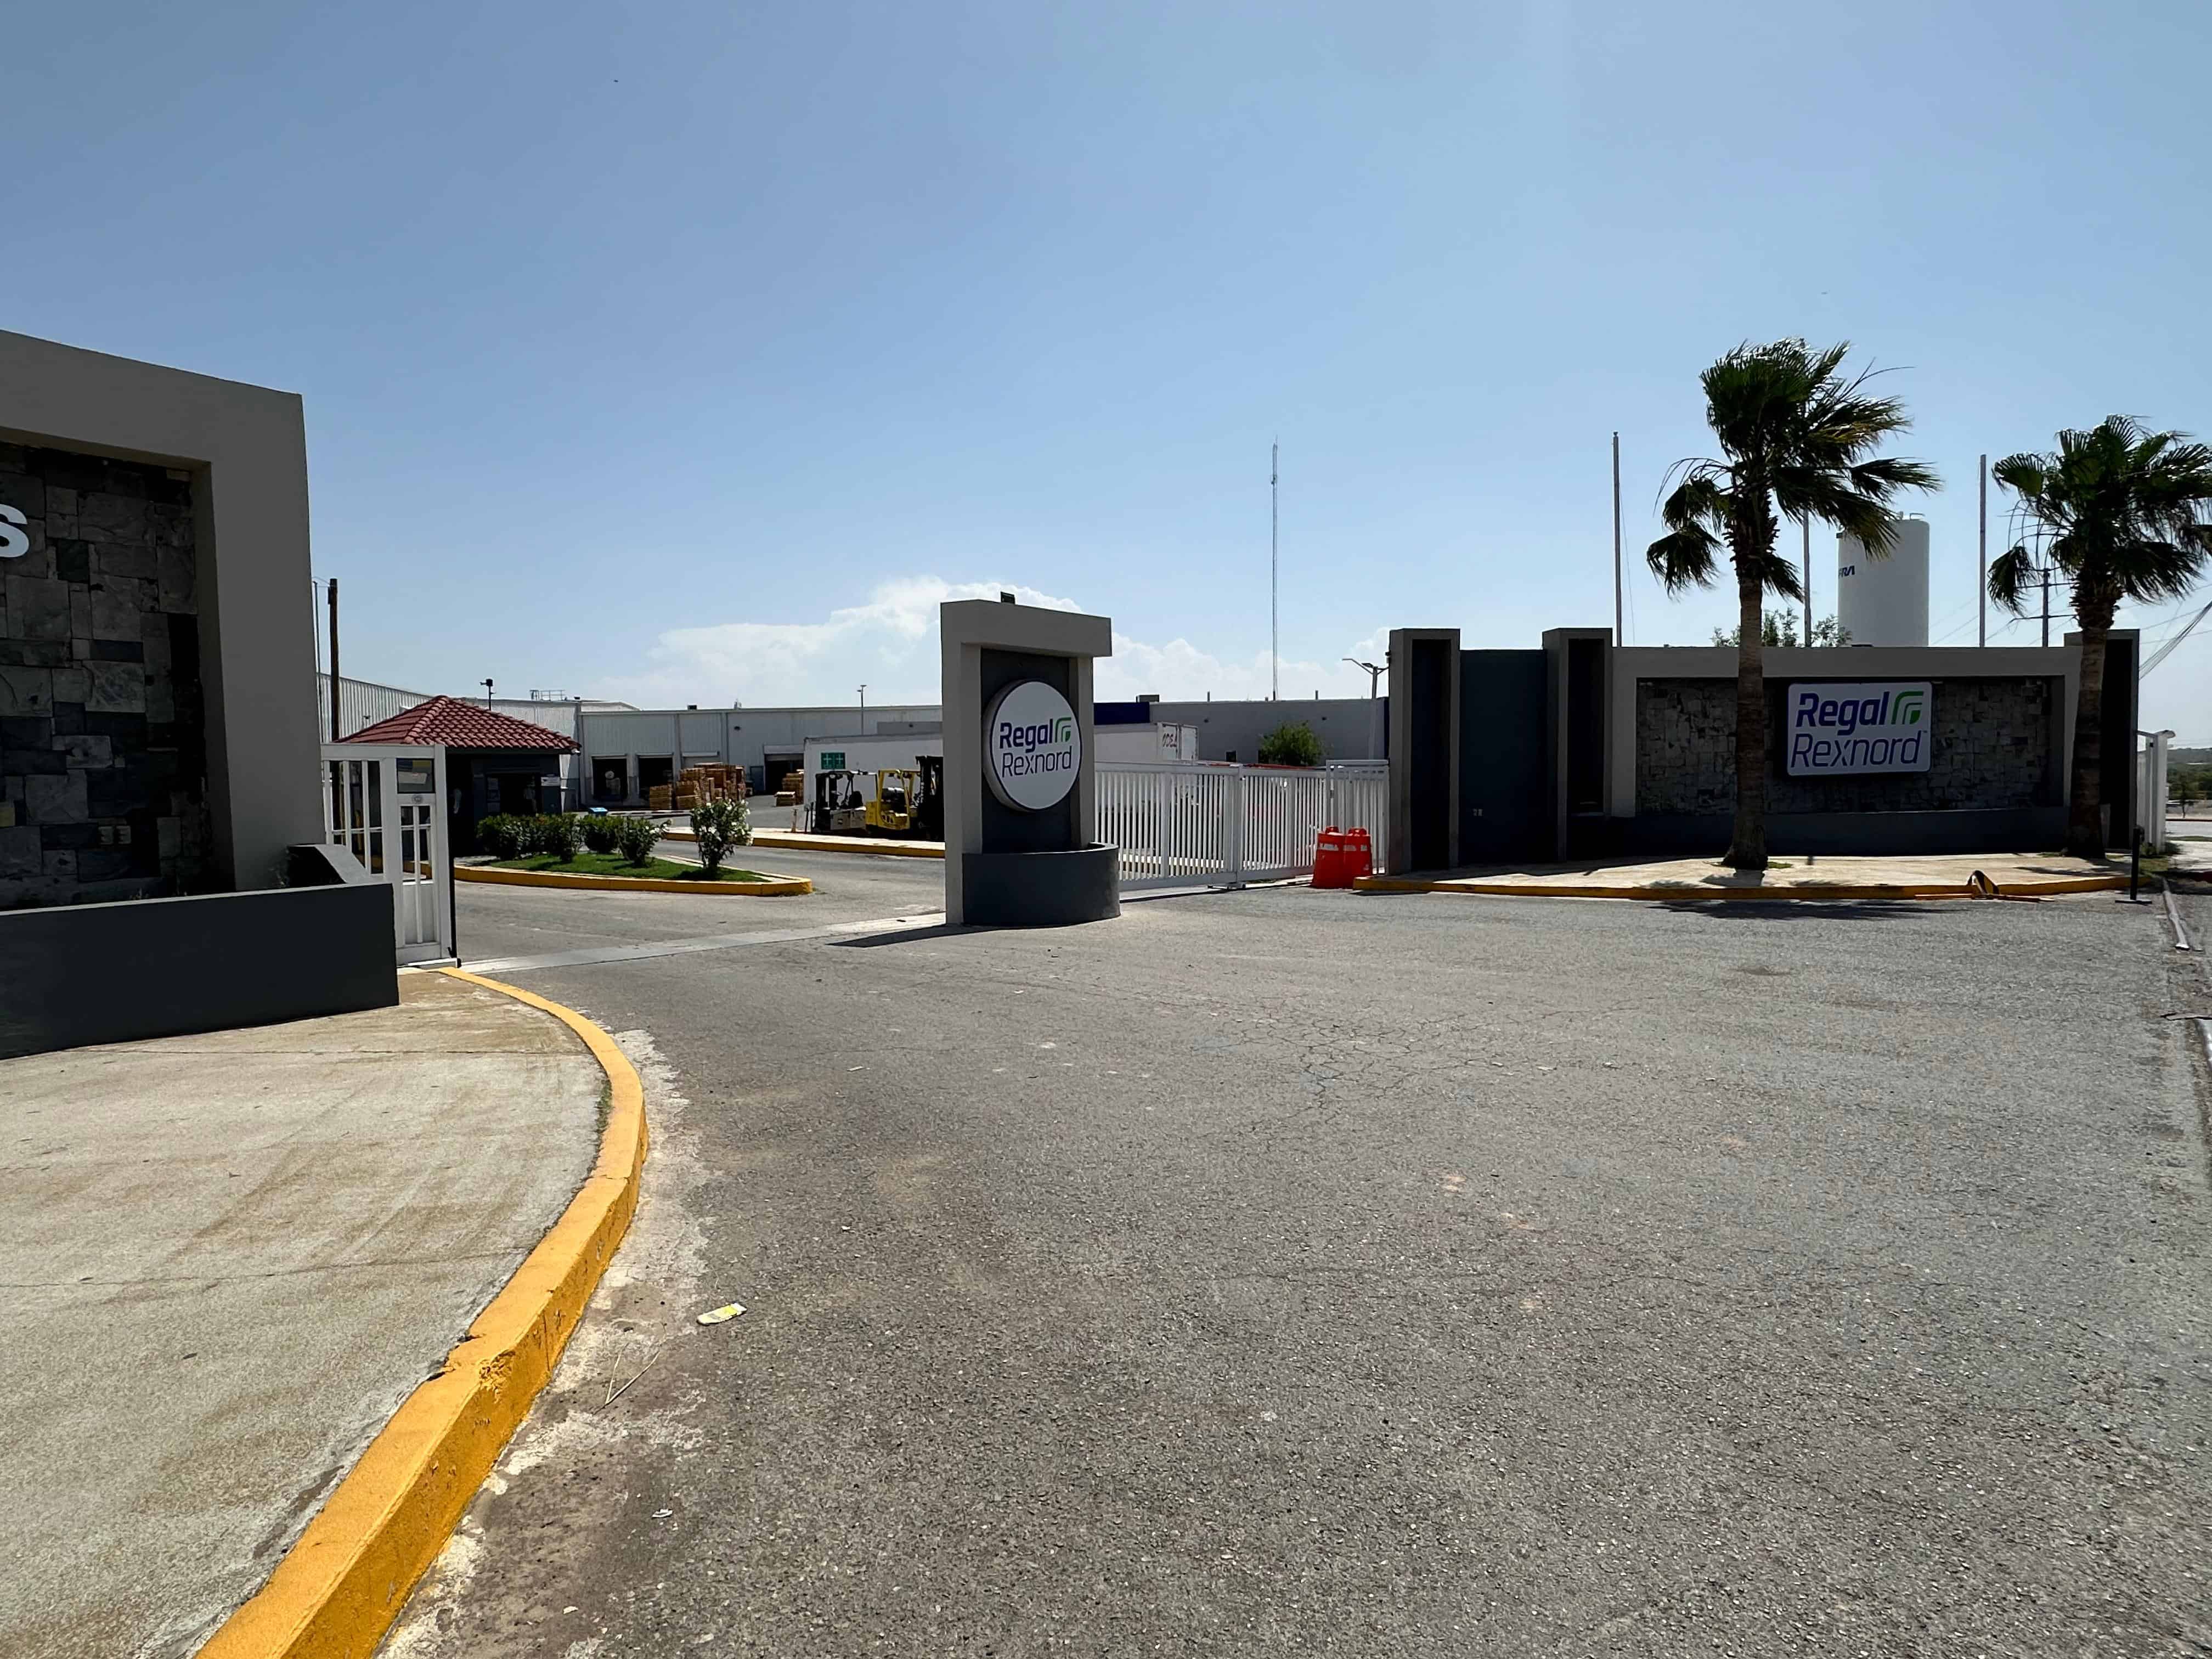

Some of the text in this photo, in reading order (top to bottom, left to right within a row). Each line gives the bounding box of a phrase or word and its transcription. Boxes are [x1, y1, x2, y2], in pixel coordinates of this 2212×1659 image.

[1796, 691, 1890, 736] Regal
[1000, 718, 1053, 753] Regal
[1791, 730, 1922, 768] Rexnord
[1002, 746, 1072, 777] Rexnord
